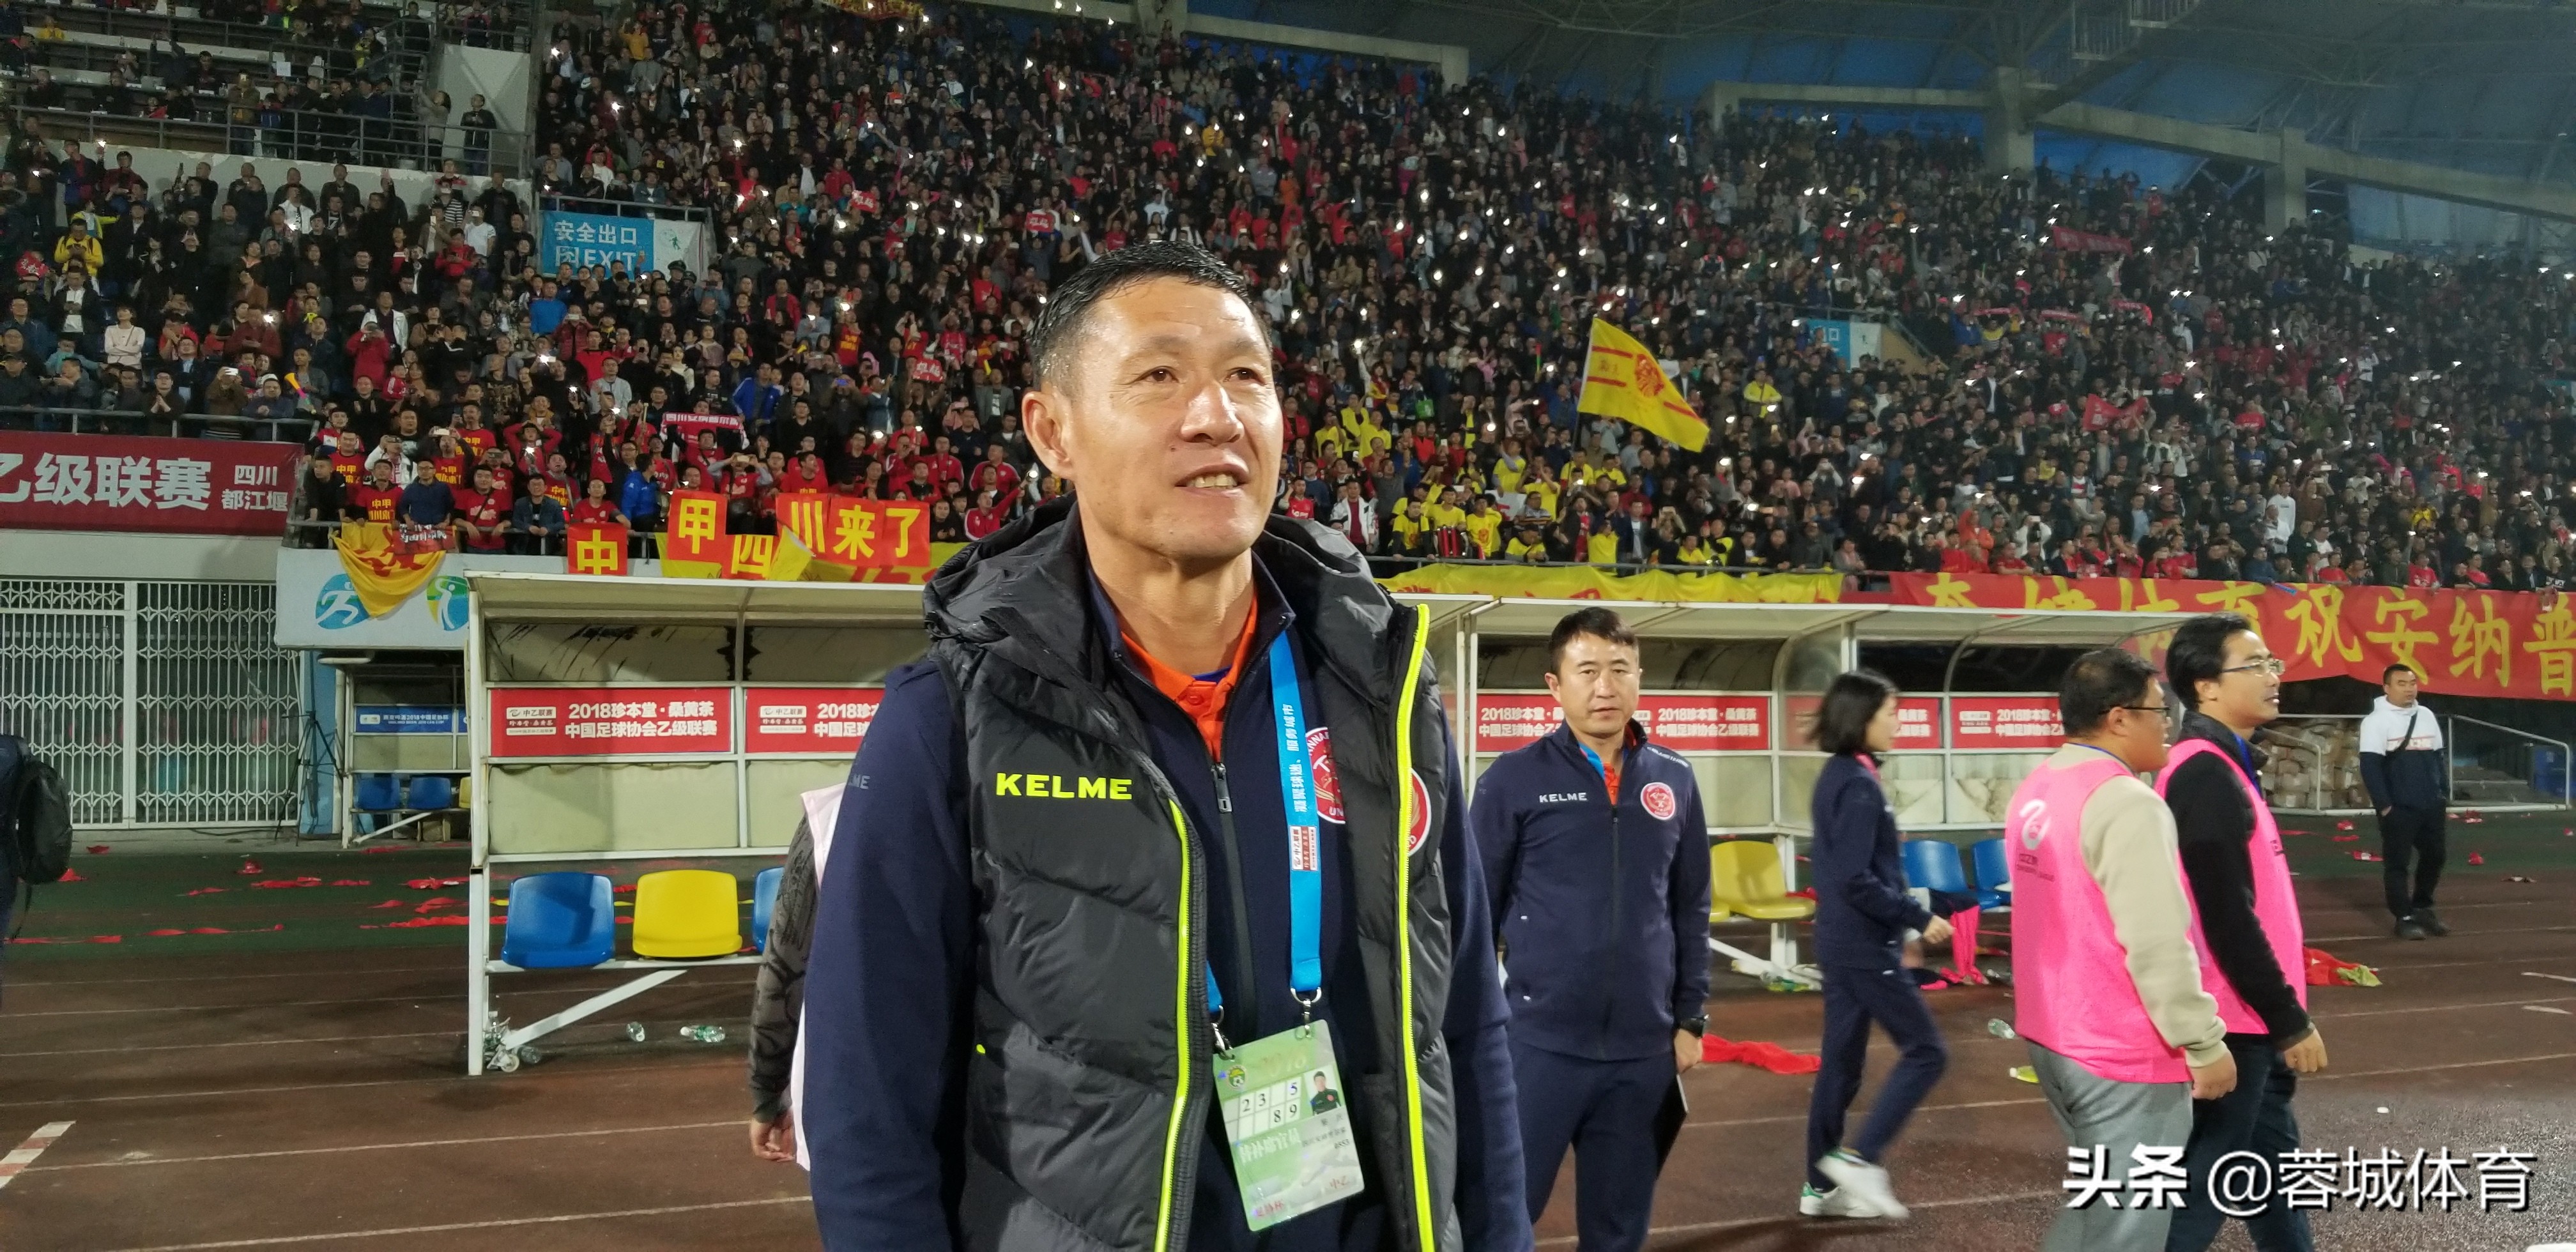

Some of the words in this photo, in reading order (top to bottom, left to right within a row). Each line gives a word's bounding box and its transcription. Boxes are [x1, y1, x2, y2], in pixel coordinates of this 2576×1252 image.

[555, 220, 637, 245] 安全出口
[584, 248, 636, 272] EXIT
[0, 452, 211, 510] 乙级联赛
[234, 464, 277, 486] 四川
[221, 489, 288, 512] 都江堰
[372, 498, 392, 508] 中甲
[678, 498, 716, 554] 甲
[791, 500, 921, 560] 川来了
[576, 530, 618, 575] 中
[731, 534, 774, 576] 四
[568, 701, 714, 719] 2018珍本堂·桑黄茶
[565, 720, 717, 739] 中国足球协会乙级联赛
[1656, 723, 1759, 738] 中国足球协会乙级联赛
[996, 772, 1132, 800] KELME
[1539, 792, 1588, 803] KELME
[1241, 1098, 1251, 1112] 2
[1257, 1093, 1266, 1106] 3
[1289, 1081, 1298, 1096] 5
[1273, 1110, 1282, 1123] 8
[1289, 1104, 1297, 1118] 9
